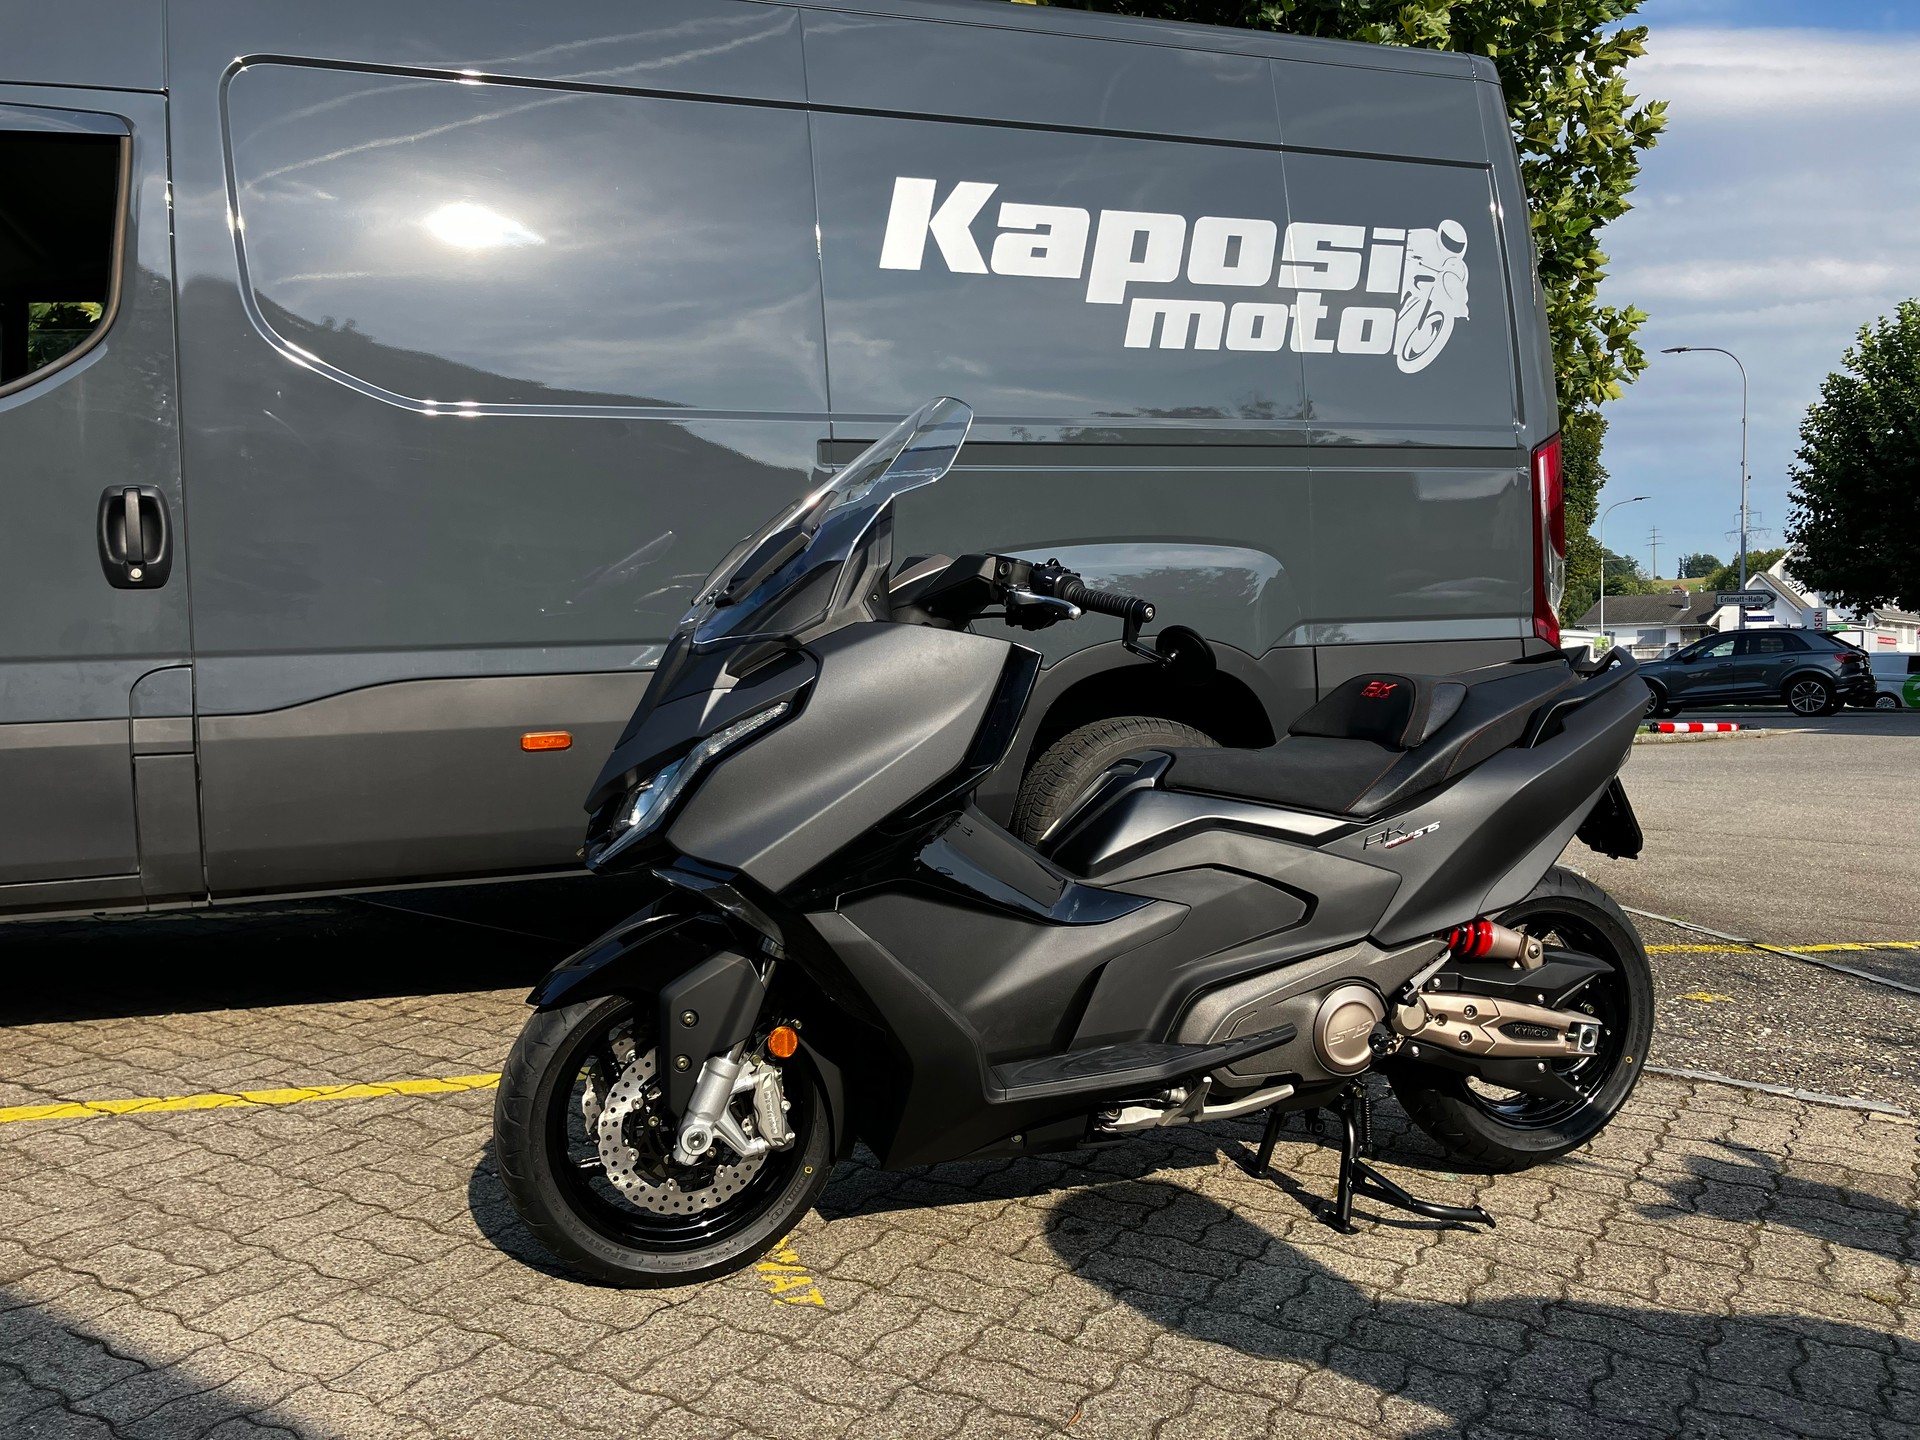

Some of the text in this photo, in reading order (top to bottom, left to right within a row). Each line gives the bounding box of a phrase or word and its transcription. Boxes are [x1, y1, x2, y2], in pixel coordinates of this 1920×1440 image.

[879, 176, 1406, 304] Kaposi
[1123, 292, 1399, 355] moto
[1514, 1026, 1549, 1038] KYMCO
